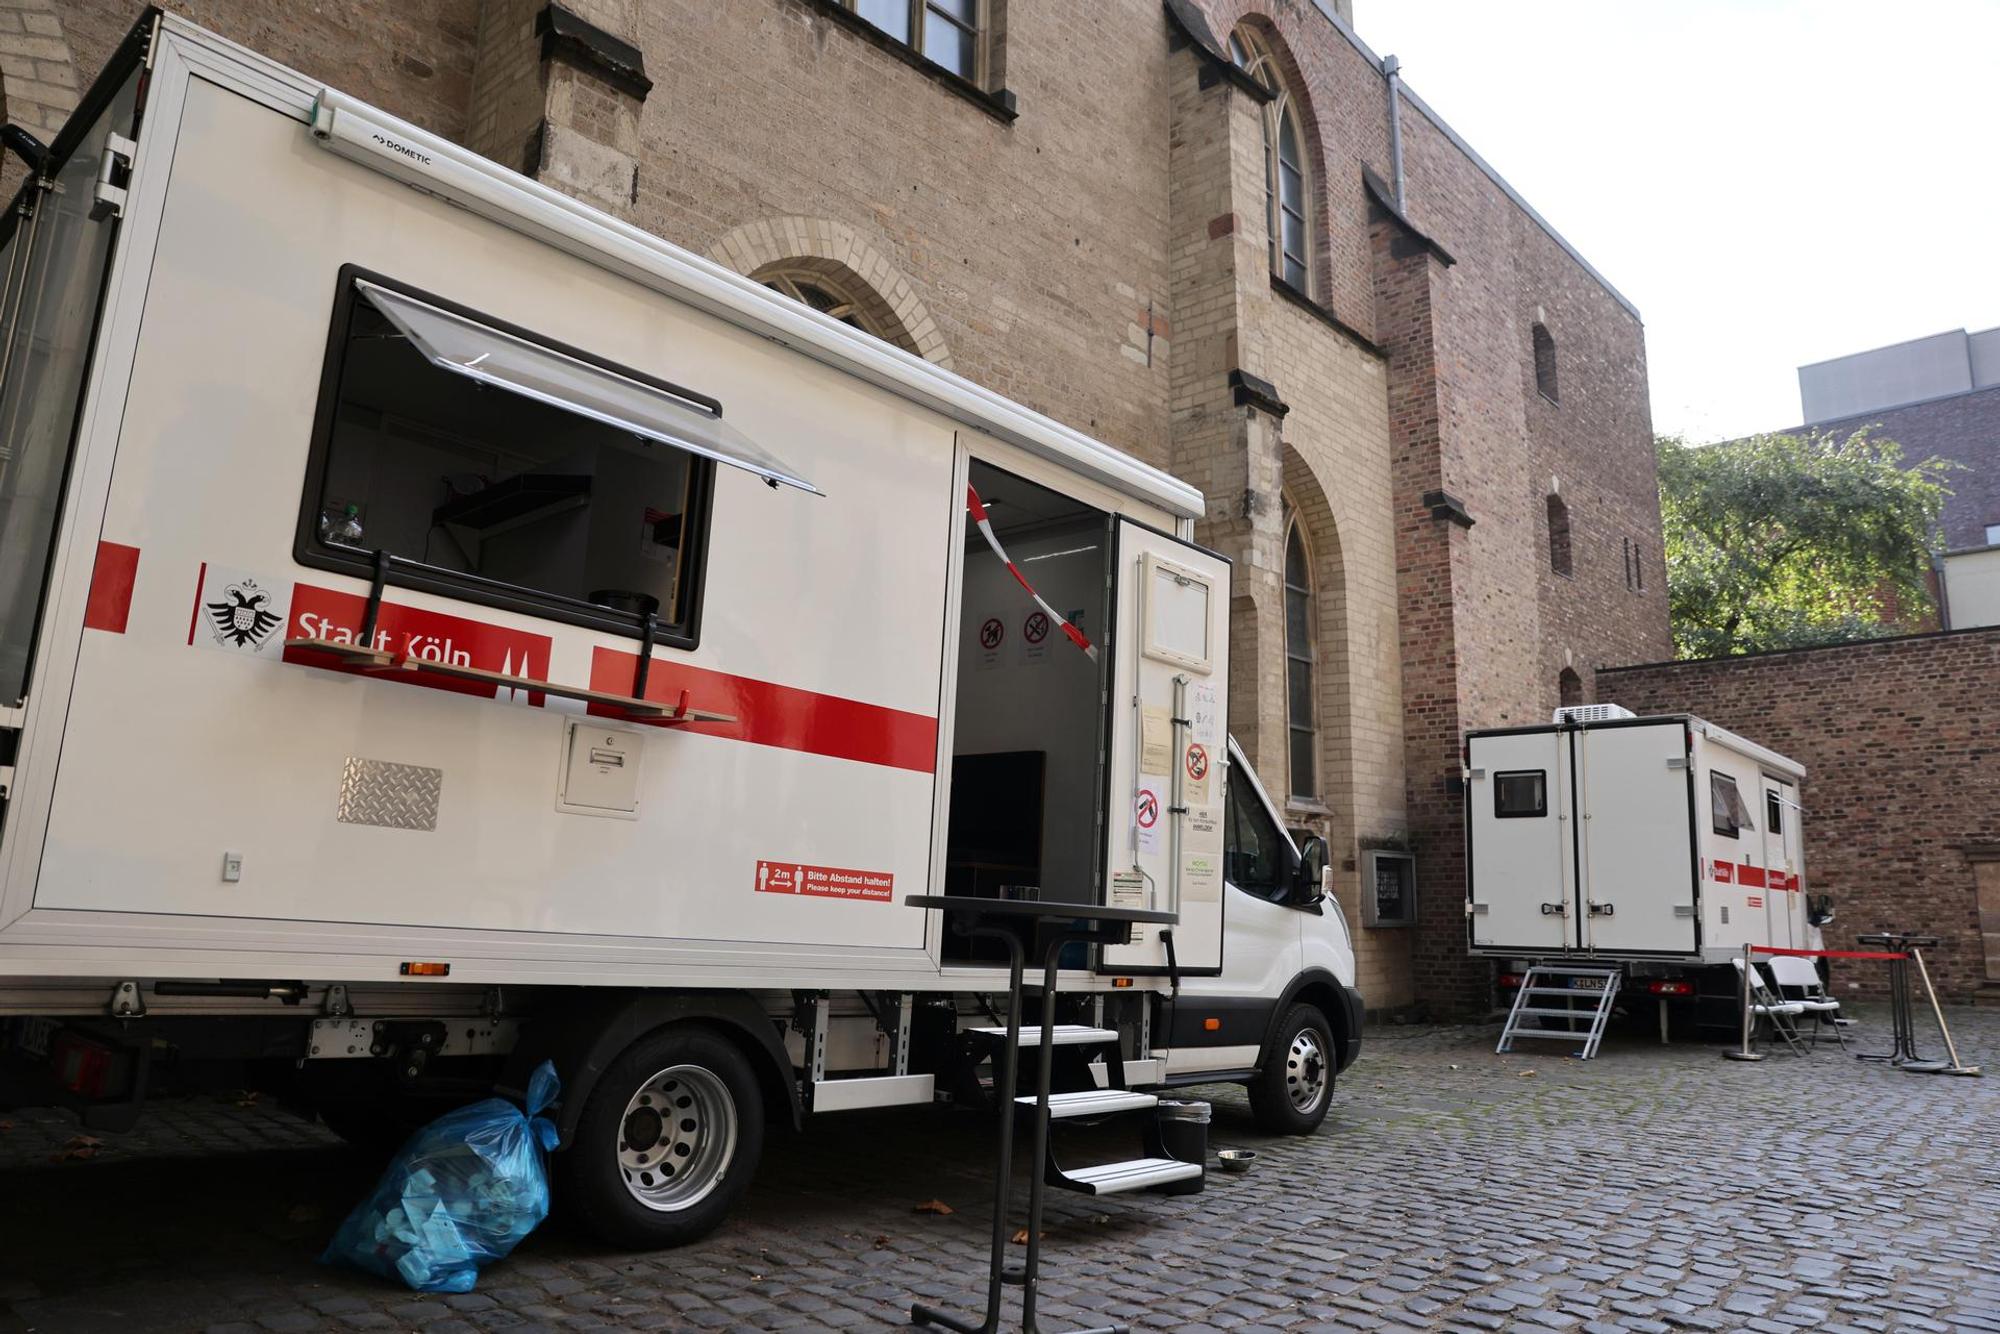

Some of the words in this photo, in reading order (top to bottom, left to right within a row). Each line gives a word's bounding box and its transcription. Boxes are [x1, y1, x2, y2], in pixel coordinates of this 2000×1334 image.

[386, 140, 432, 165] DOMETIC
[774, 868, 790, 879] 2m
[807, 871, 828, 882] Bitte
[829, 873, 863, 884] Abstand
[864, 876, 891, 887] halten!
[806, 883, 829, 892] Please
[830, 885, 846, 894] keep
[847, 887, 861, 895] your
[862, 888, 890, 897] distance!
